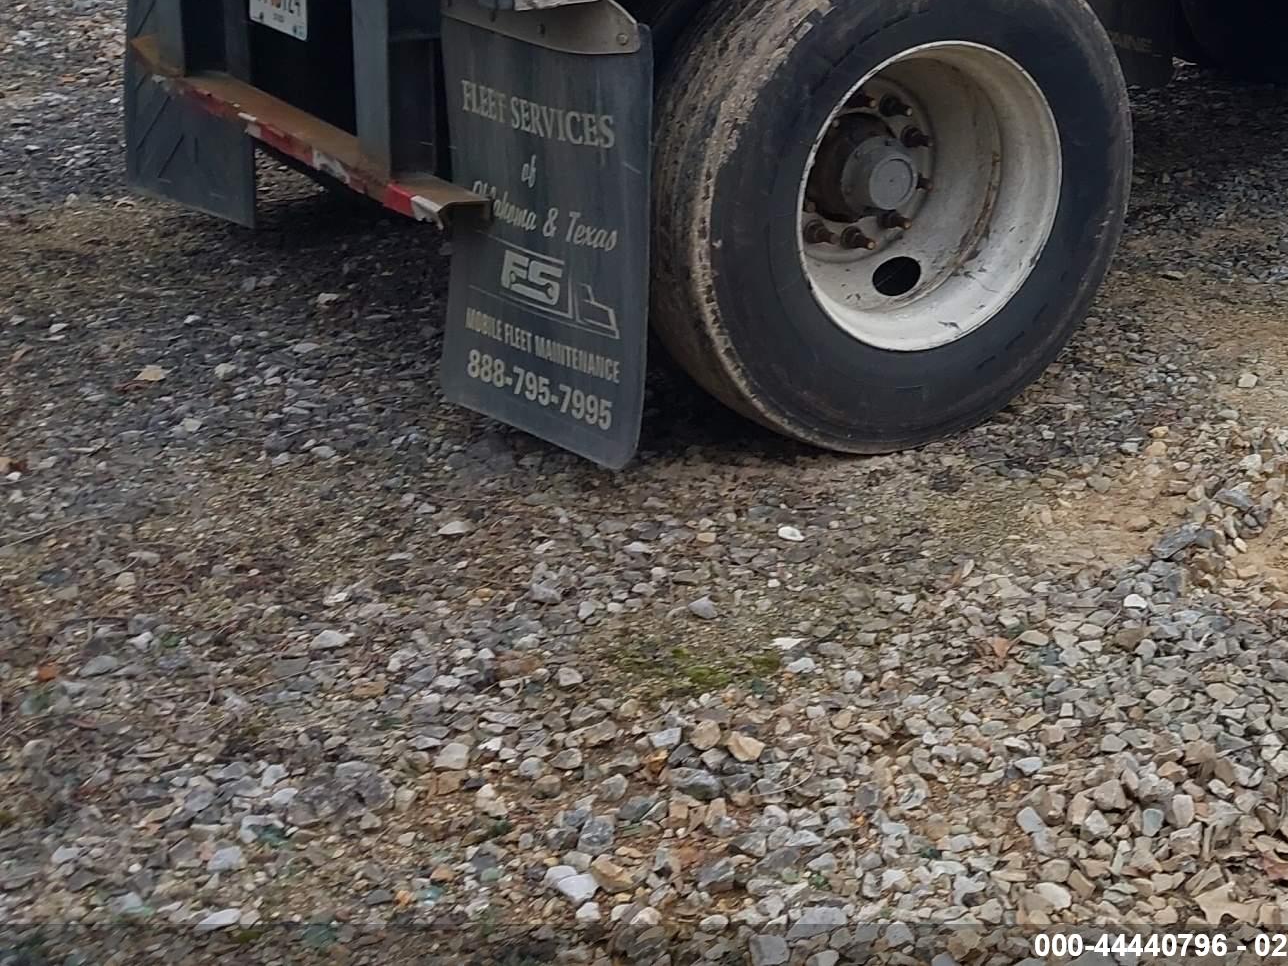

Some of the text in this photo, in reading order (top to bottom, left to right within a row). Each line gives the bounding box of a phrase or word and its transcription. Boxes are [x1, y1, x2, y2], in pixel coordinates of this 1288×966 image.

[462, 80, 615, 148] FLEET SERVICES
[521, 154, 537, 188] of
[542, 207, 559, 237] &
[566, 211, 619, 252] Texas
[504, 322, 533, 354] FLEET
[534, 334, 621, 384] MAINTENANCE
[466, 348, 614, 431] 888-795-7995
